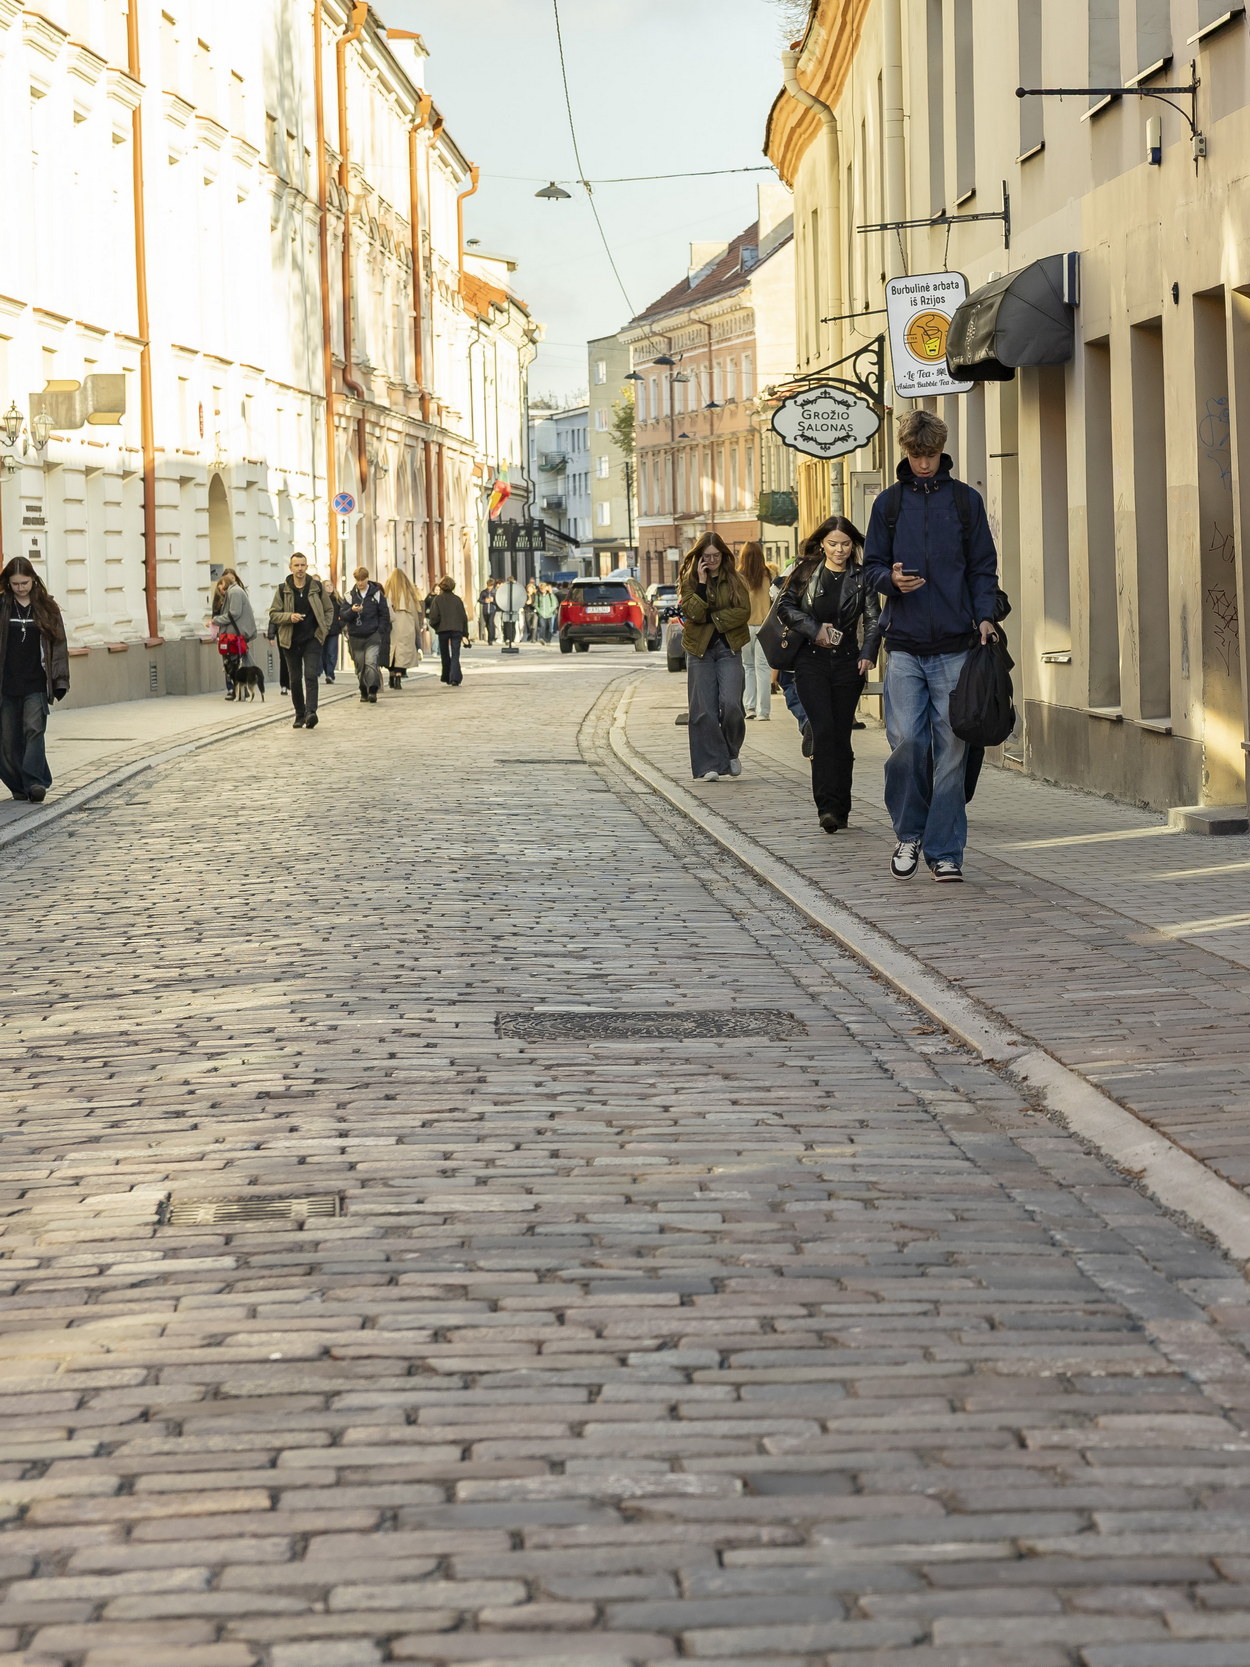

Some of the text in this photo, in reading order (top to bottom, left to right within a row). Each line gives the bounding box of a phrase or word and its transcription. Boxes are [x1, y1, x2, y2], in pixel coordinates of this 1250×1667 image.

[891, 281, 960, 296] Burbulinė arbata
[910, 295, 946, 307] iš Azijos
[897, 382, 916, 391] Asian
[916, 380, 938, 388] Bubble
[939, 378, 950, 386] Tea
[801, 409, 850, 420] GROŽIO
[797, 421, 854, 432] SALONAS
